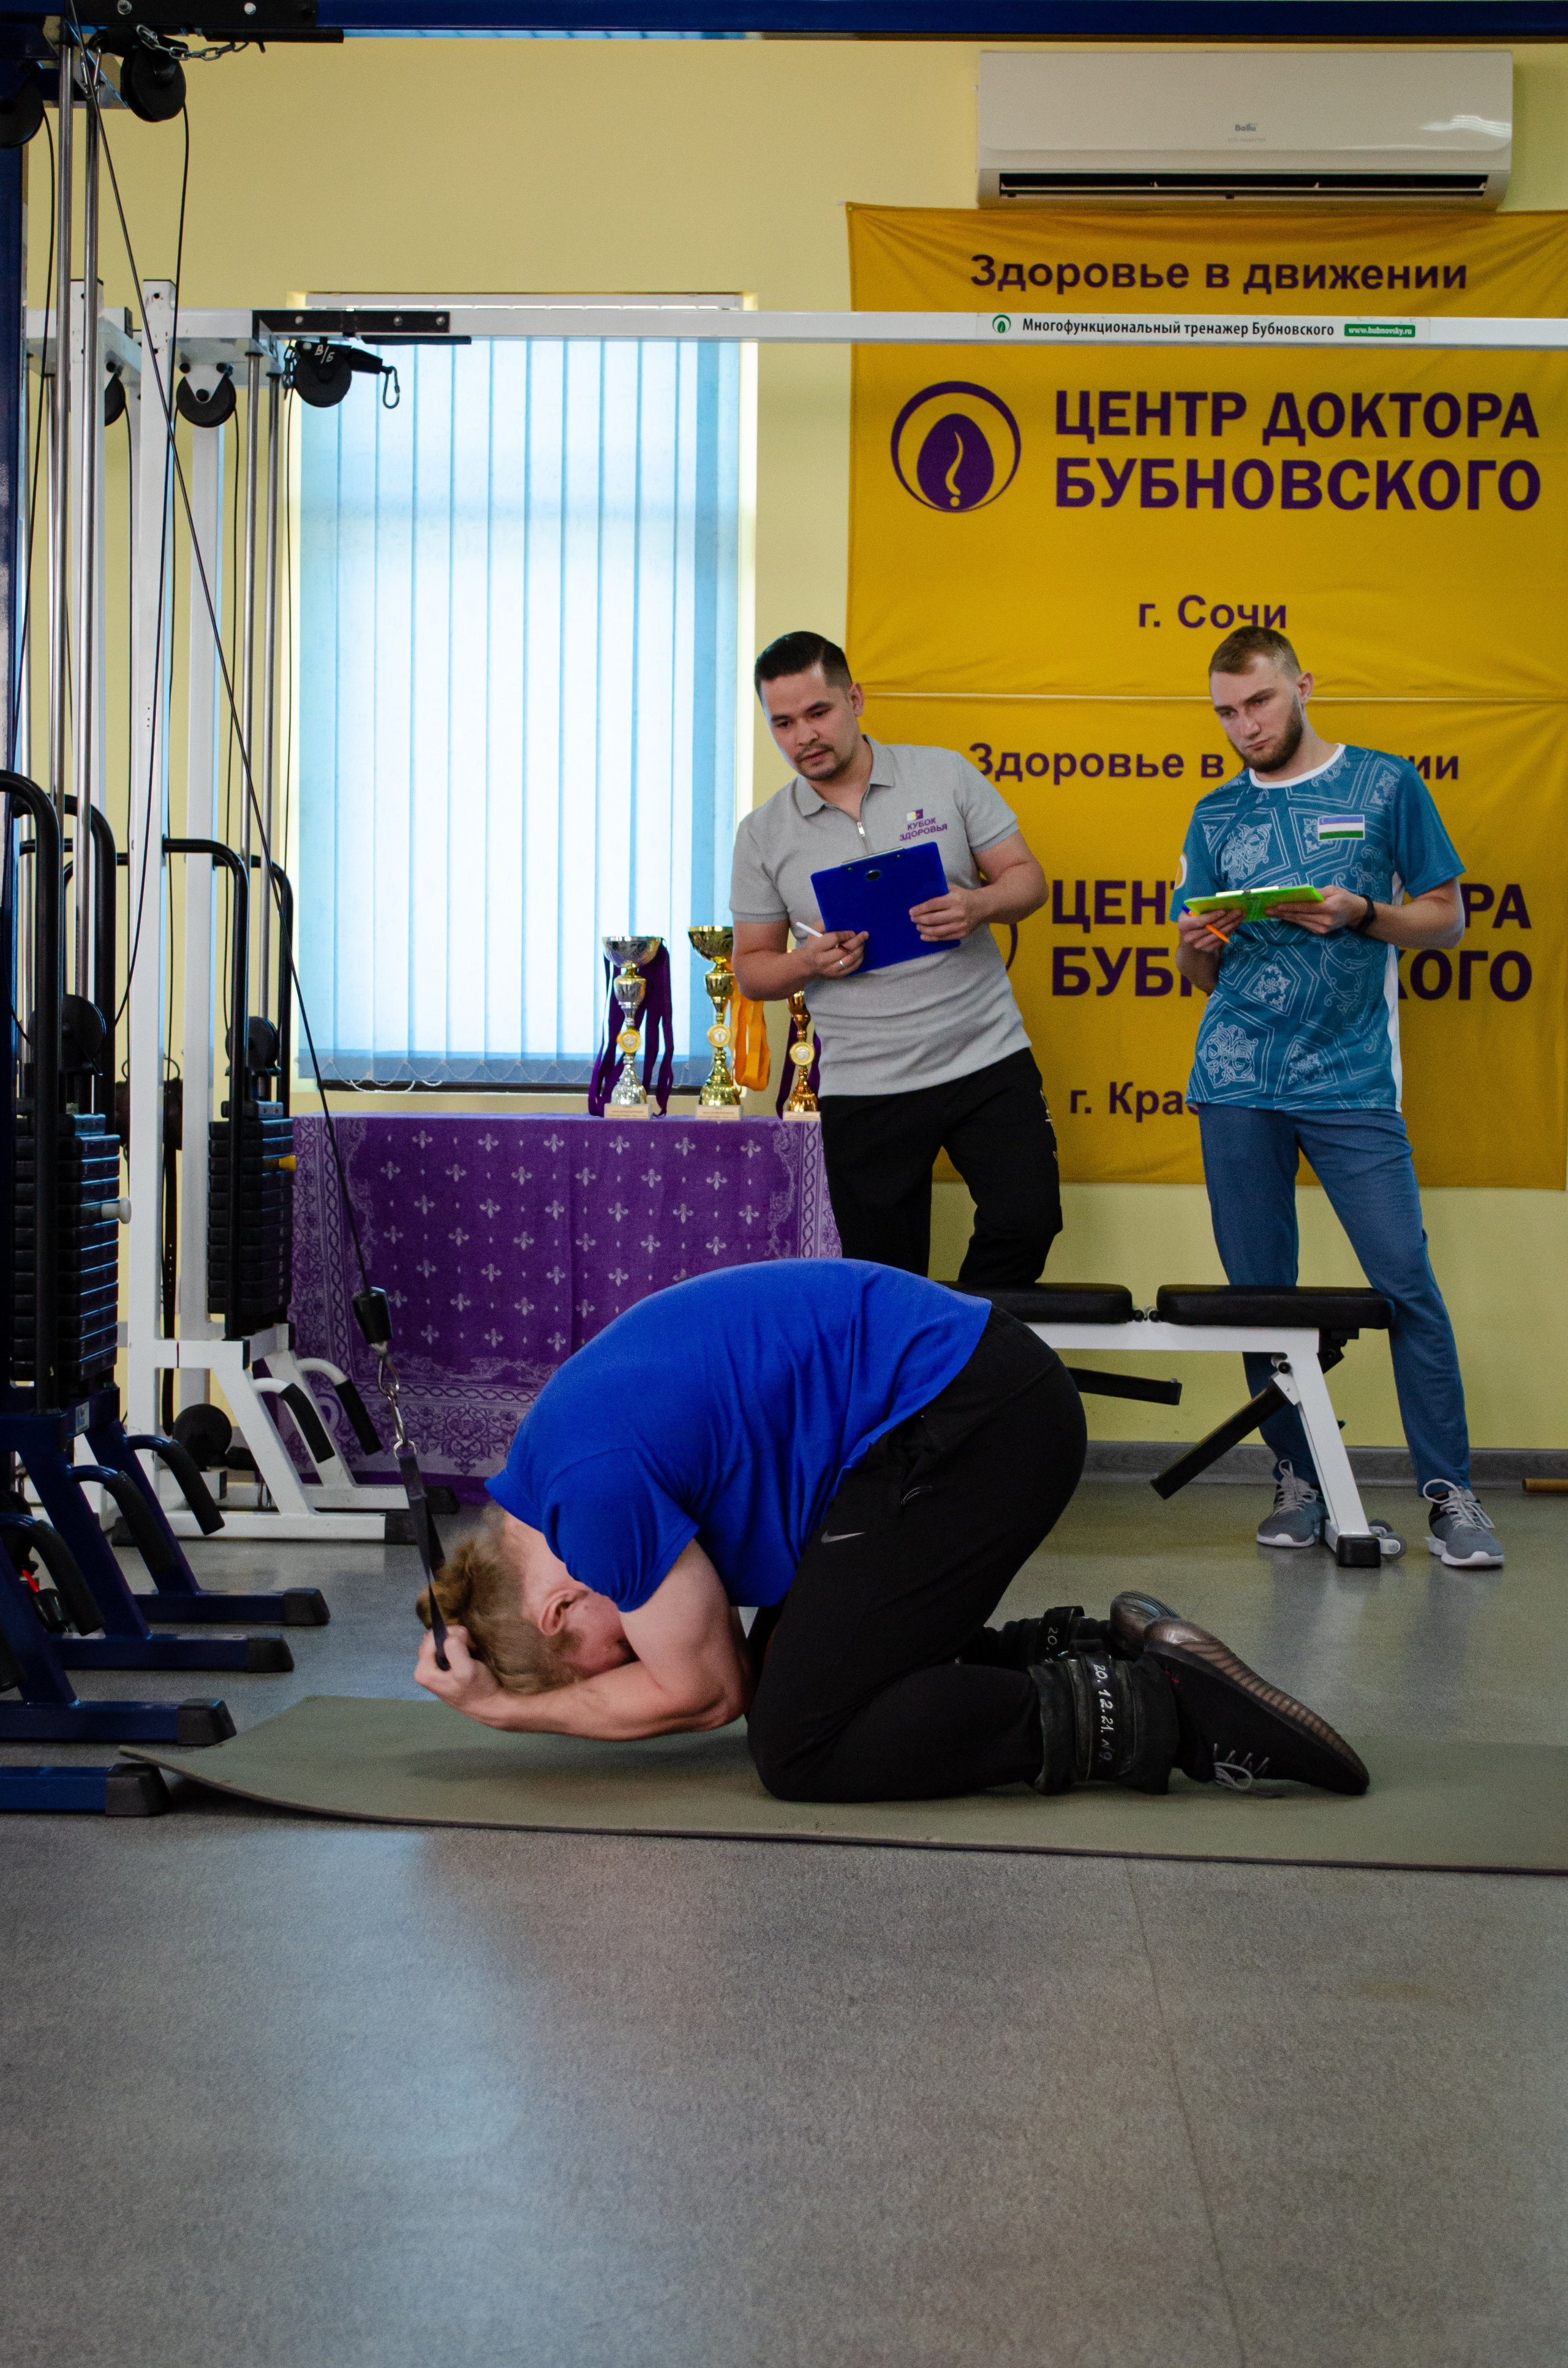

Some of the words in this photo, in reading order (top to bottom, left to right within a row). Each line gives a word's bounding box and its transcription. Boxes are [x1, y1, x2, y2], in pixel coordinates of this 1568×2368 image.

[971, 254, 1189, 295] Здоровье
[1205, 263, 1229, 288] в
[1243, 264, 1466, 295] движении
[1022, 318, 1180, 335] Многофункциональный
[1184, 323, 1248, 337] тренажер
[1253, 322, 1334, 338] Бубновского
[1348, 326, 1412, 336] www.bubnovsky.ru
[1056, 390, 1247, 444] ЦЕНТР
[1262, 392, 1540, 446] ДОКТОРА
[1056, 457, 1541, 511] БУБНОВСКОГО
[1139, 603, 1161, 627] г.
[1177, 594, 1286, 629] Сочи
[969, 742, 1185, 785] Здоровье
[1200, 754, 1224, 778] в
[899, 823, 948, 841] ЗДОРОВЬЯ
[907, 817, 937, 830] КУБОК
[1052, 880, 1175, 933] ЦЕН
[1070, 1089, 1091, 1114] г.
